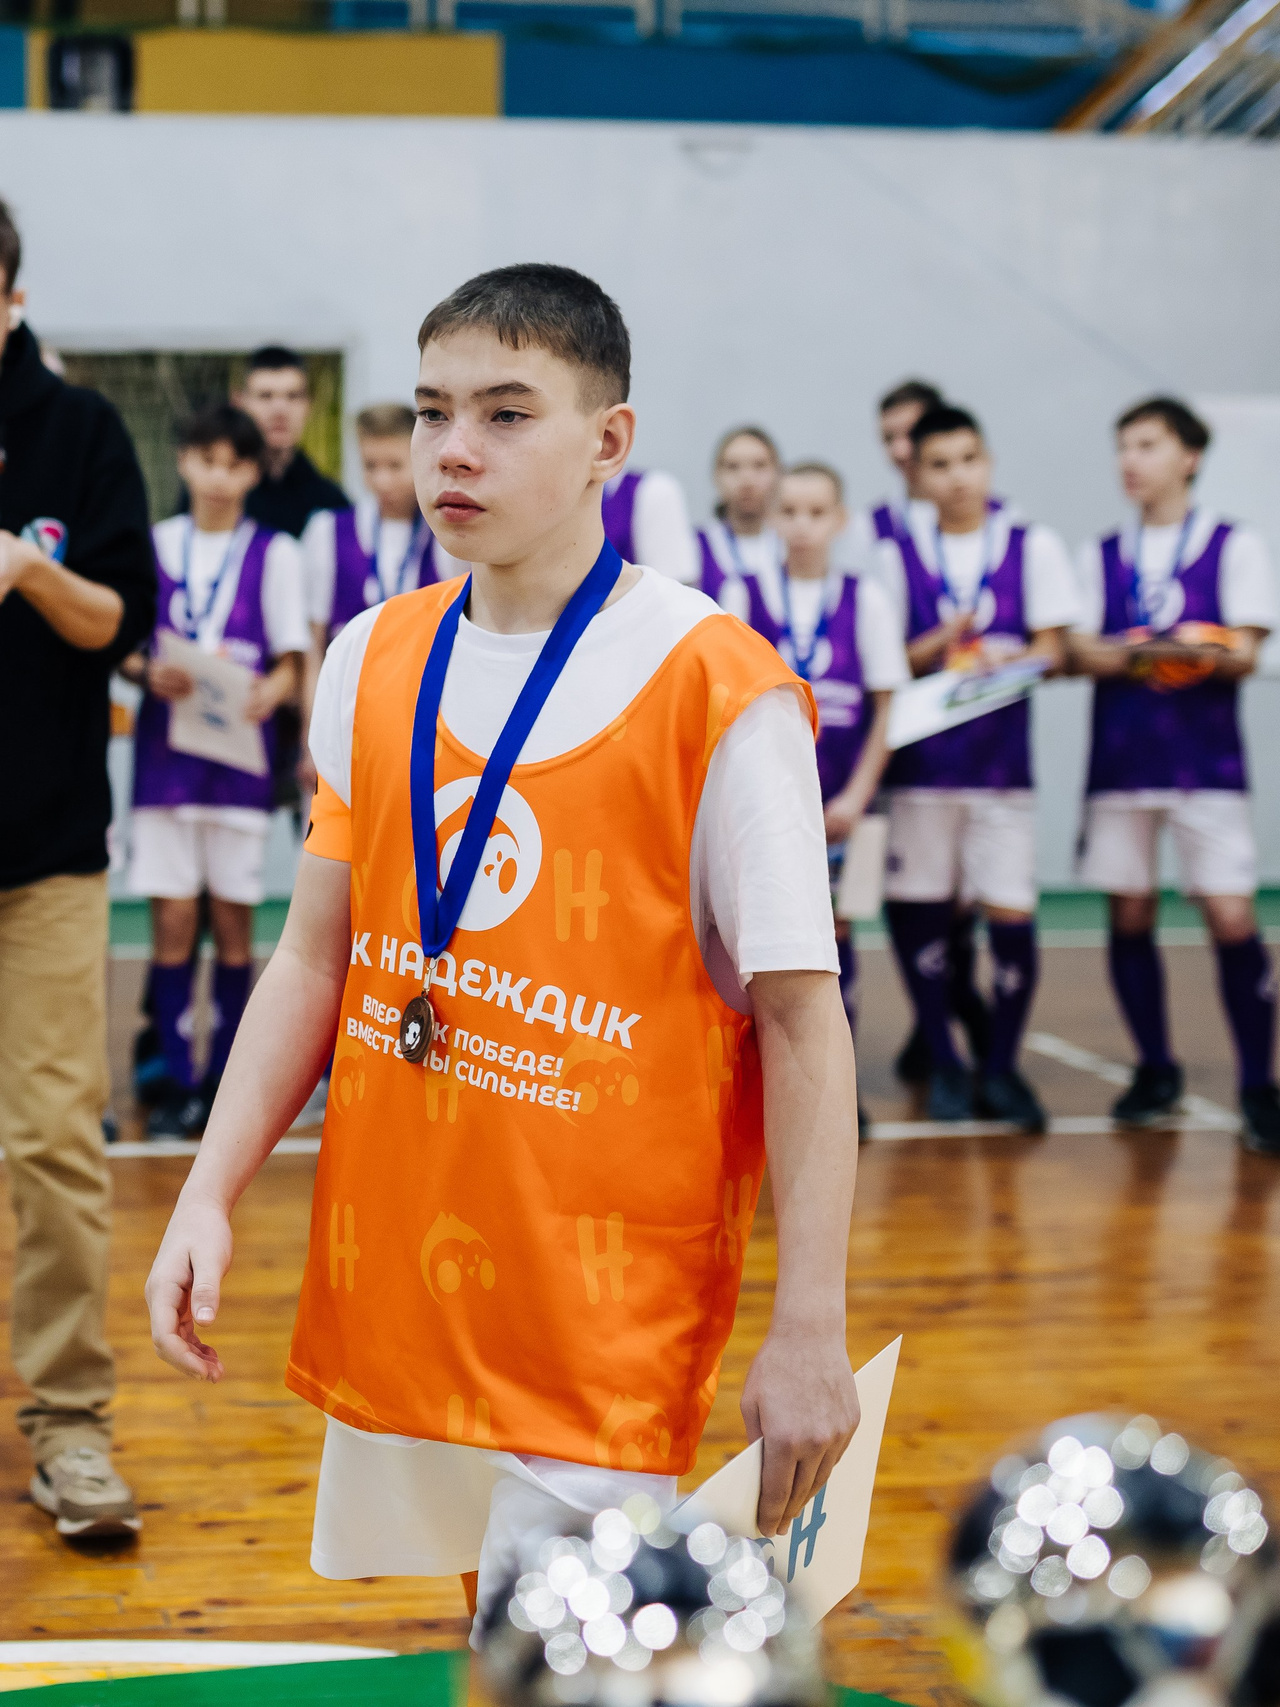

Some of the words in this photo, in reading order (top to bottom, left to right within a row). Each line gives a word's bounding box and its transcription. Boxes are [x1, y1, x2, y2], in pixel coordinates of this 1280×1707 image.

[351, 930, 373, 967] К
[380, 934, 642, 1050] НАДЕЖДИК
[362, 994, 401, 1026] ВПЕР
[433, 1021, 450, 1044] К
[453, 1028, 564, 1078] ПОБЕДЕ!
[347, 1017, 404, 1059] ВМЕСТЕ
[455, 1060, 582, 1112] СИЛЬНЕЕ!
